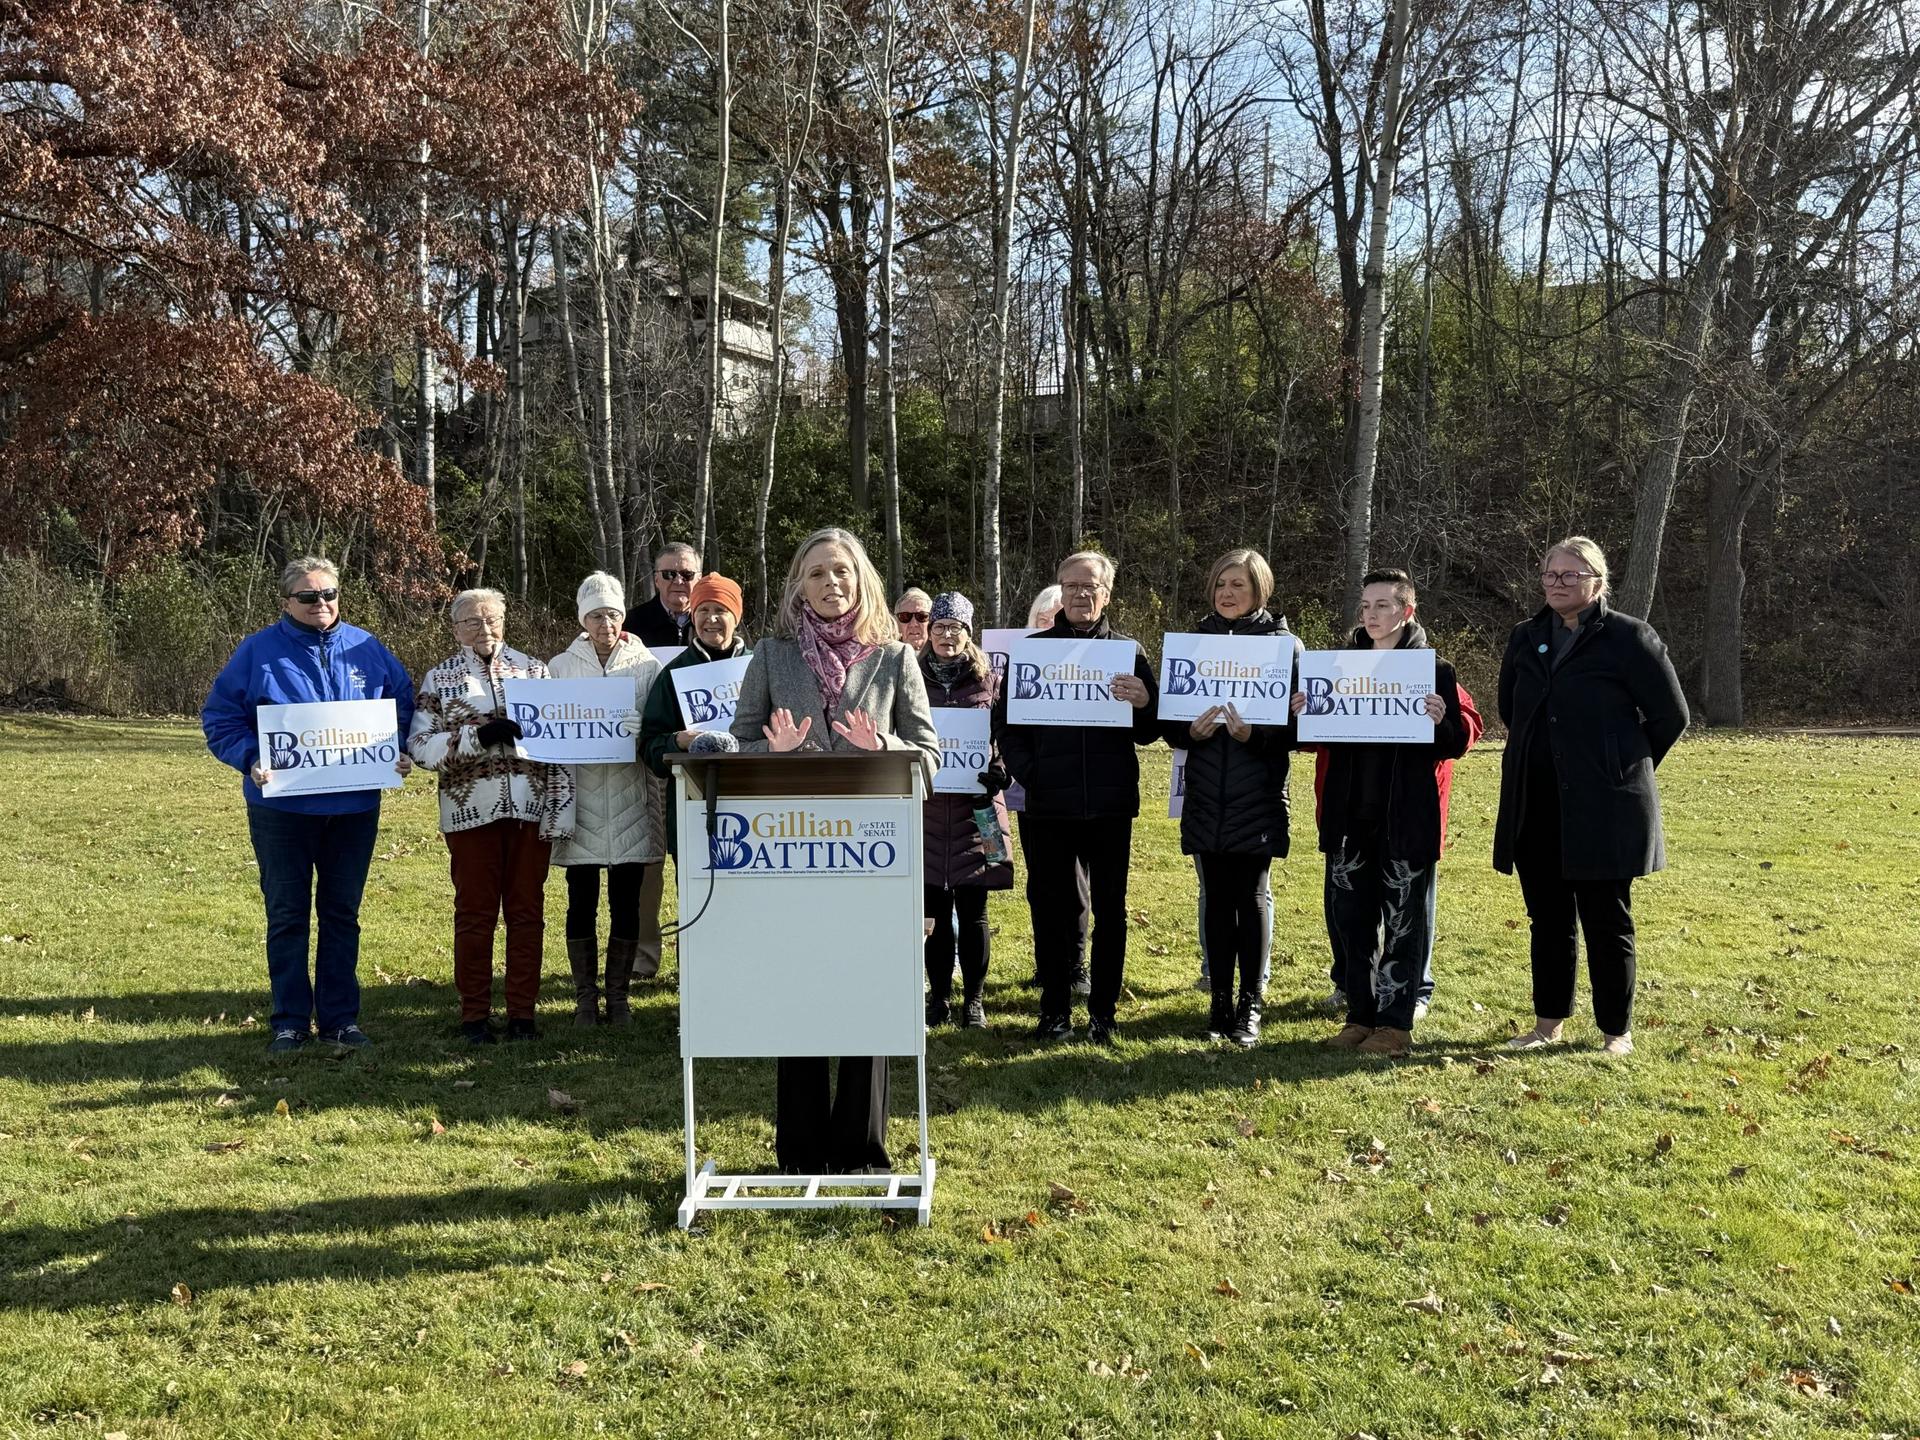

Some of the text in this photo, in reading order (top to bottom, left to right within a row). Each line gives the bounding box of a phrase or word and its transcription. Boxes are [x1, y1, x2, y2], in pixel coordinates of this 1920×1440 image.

[1042, 663, 1103, 681] Gillian
[1163, 657, 1287, 699] BATTINO
[1197, 660, 1261, 678] Gillian
[1012, 663, 1126, 701] BATTIN
[1334, 677, 1402, 695] Gillian
[1301, 677, 1428, 716] BATTINO
[540, 703, 605, 720] Gillian
[299, 728, 368, 748] Gillian
[263, 731, 396, 771] BATTINO
[752, 811, 854, 838] Gillian
[857, 821, 897, 832] for STATE
[863, 829, 897, 837] SENATE
[700, 812, 896, 870] BATTINO
